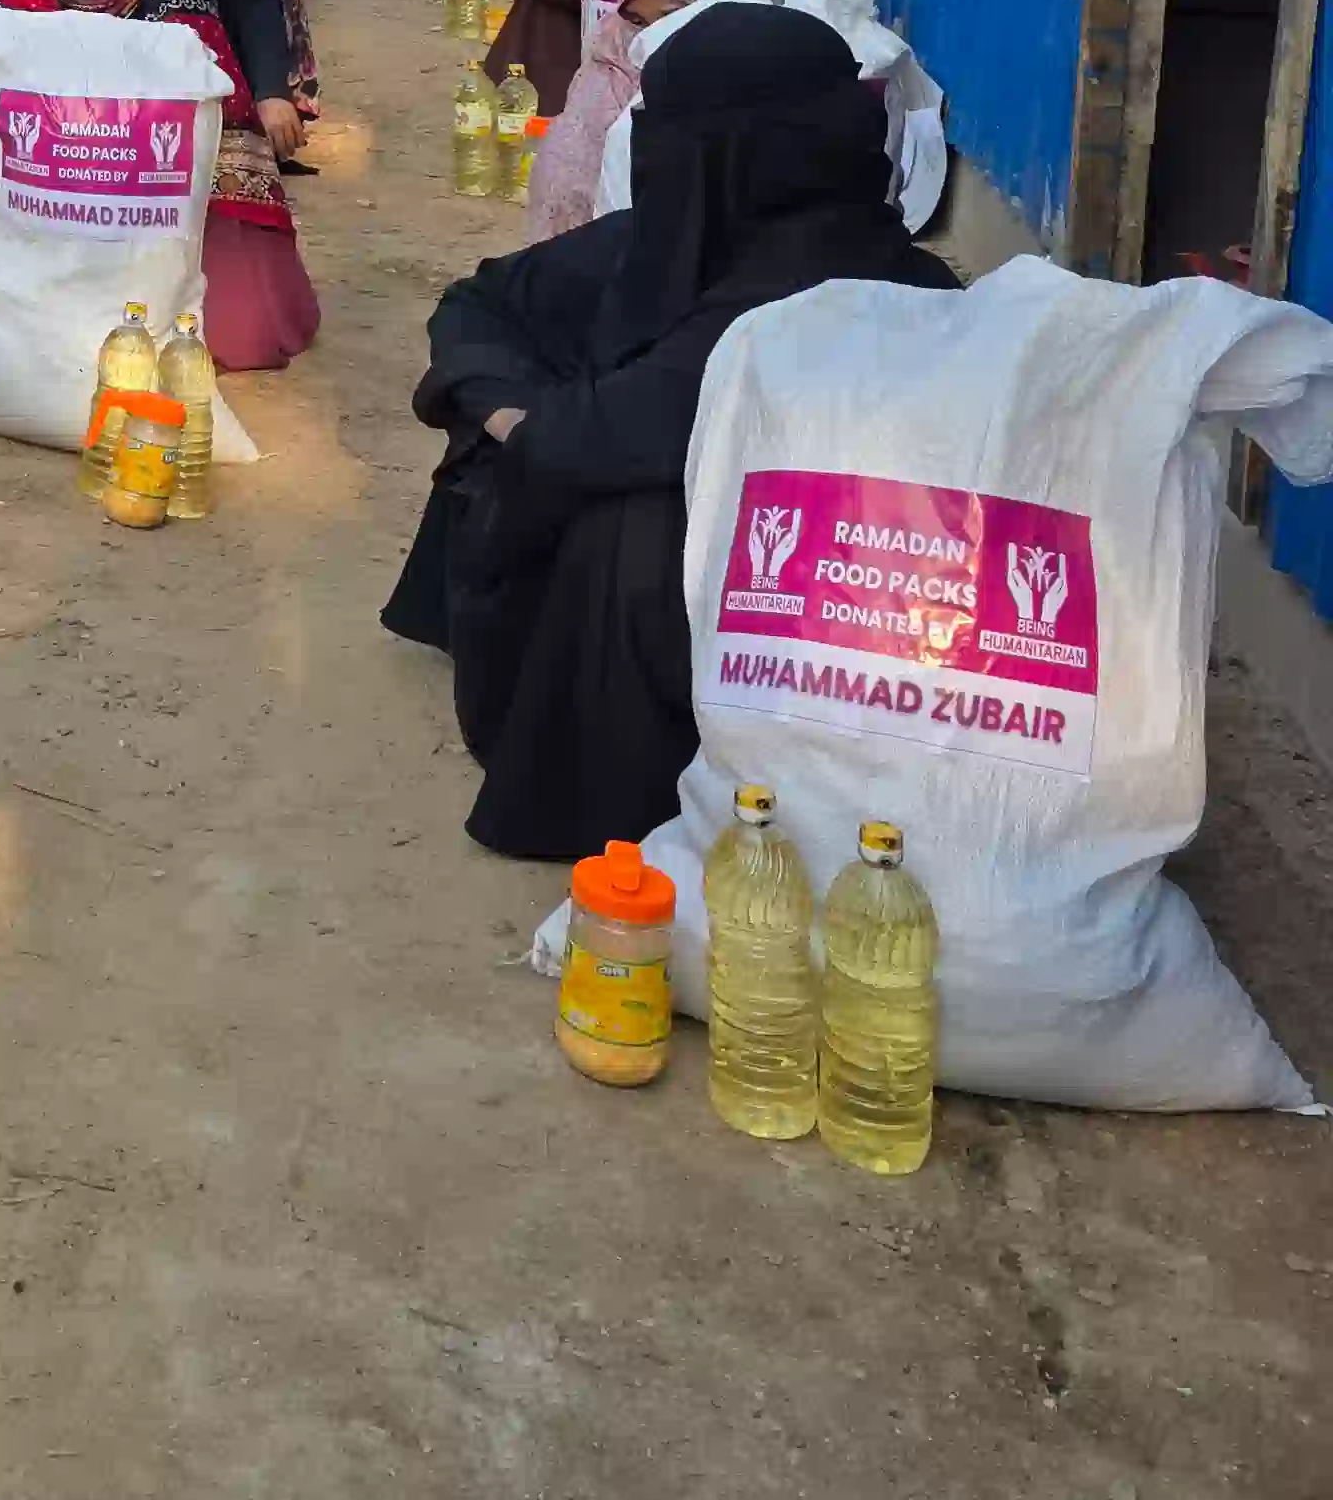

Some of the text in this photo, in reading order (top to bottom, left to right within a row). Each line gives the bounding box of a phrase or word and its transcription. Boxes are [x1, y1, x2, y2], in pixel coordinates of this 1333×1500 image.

[61, 122, 130, 139] RAMADAN
[52, 144, 137, 162] FOOD PACKS
[58, 167, 112, 182] DONATED
[113, 171, 129, 183] BY
[8, 189, 179, 229] MUHAMMAD ZUBAIR
[833, 519, 967, 565] RAMADAN
[750, 575, 780, 591] BEING
[814, 558, 978, 608] FOOD PACKS
[726, 592, 804, 615] HUMANITARIAN
[821, 601, 923, 637] DONATED
[1016, 618, 1056, 639] BEING
[982, 634, 1085, 666] HUMANITARIAN
[720, 650, 1067, 744] MUHAMMAD ZUBAIR
